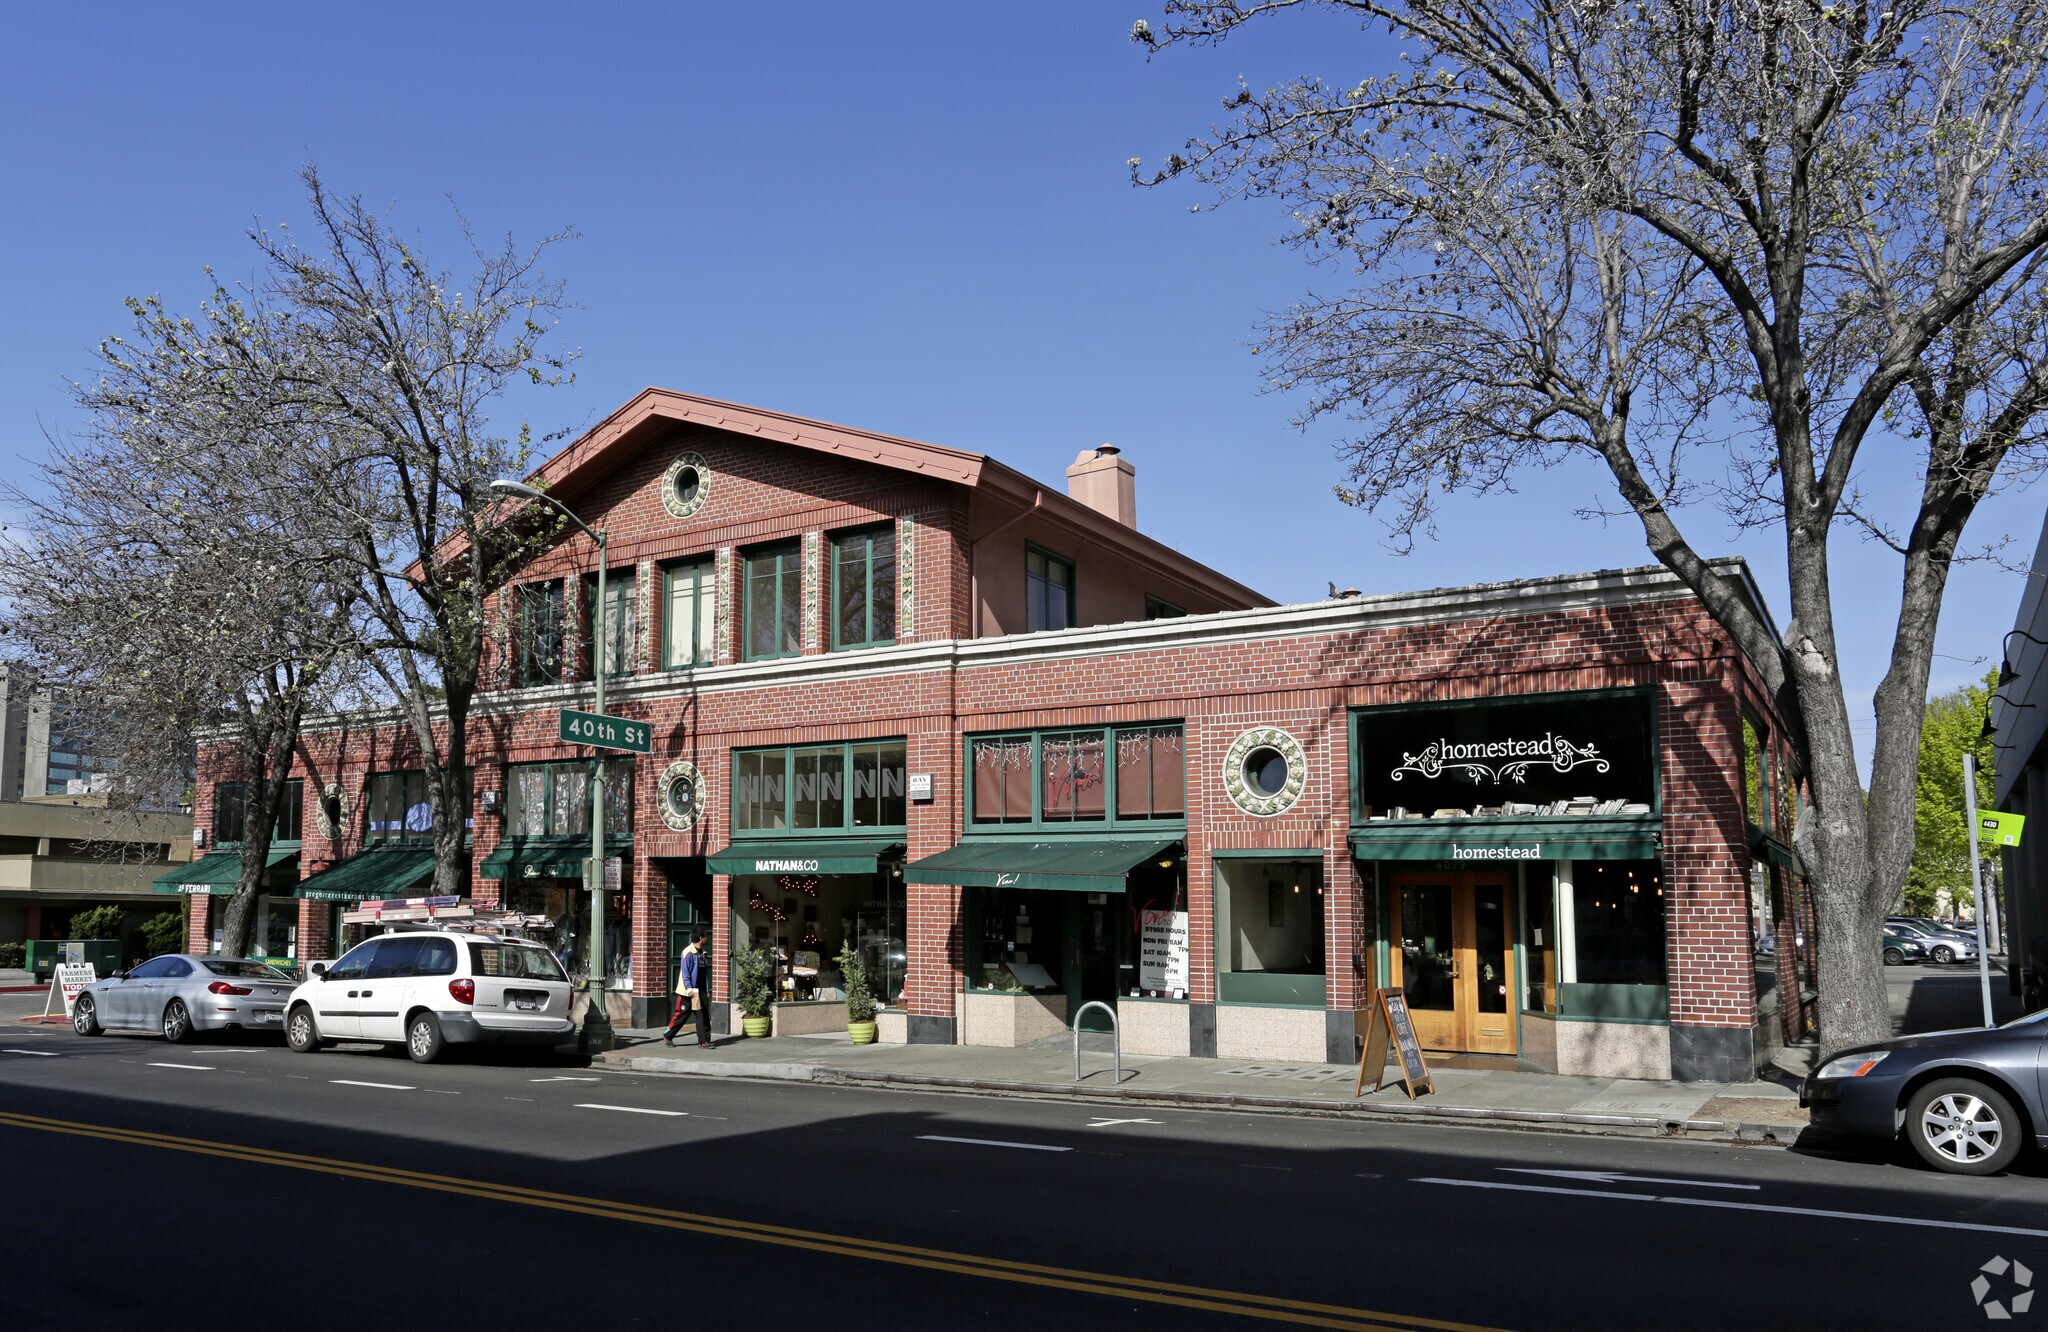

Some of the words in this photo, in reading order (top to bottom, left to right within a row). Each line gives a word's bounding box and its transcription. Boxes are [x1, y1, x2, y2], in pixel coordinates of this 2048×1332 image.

[569, 719, 615, 740] 40th
[625, 727, 644, 745] St
[1440, 732, 1554, 760] homestead
[1983, 820, 1997, 828] 4430
[1452, 843, 1541, 859] homestead
[755, 860, 819, 871] NATHAN&CO
[185, 884, 211, 893] FERRARI
[1165, 927, 1186, 935] HOURS
[264, 958, 292, 967] SANDWICHES
